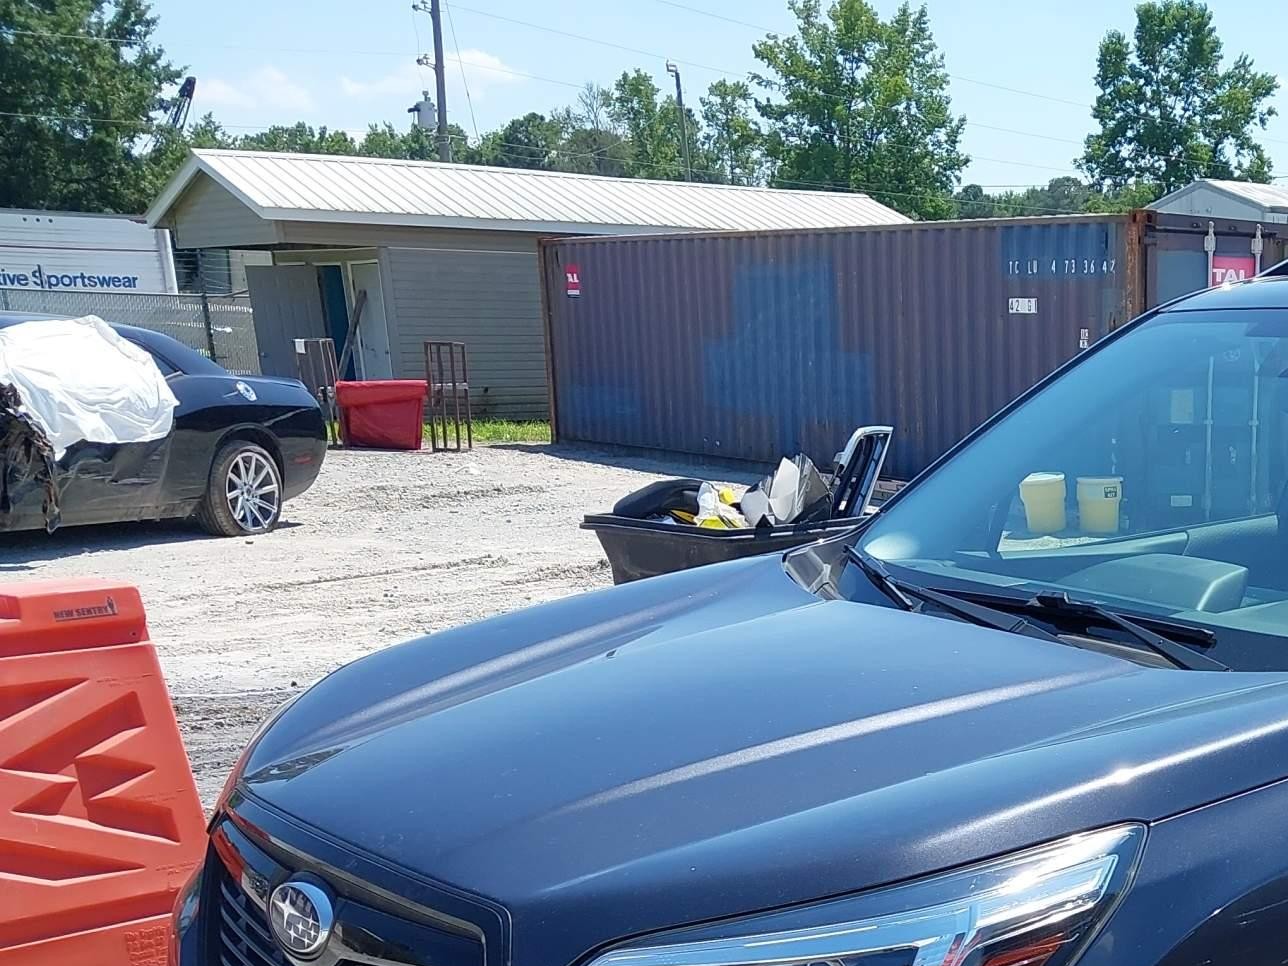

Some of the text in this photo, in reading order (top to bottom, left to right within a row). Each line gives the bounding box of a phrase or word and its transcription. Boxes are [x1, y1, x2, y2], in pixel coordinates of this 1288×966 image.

[32, 264, 138, 289] Sportswear
[53, 605, 108, 618] NEW SENTRY
